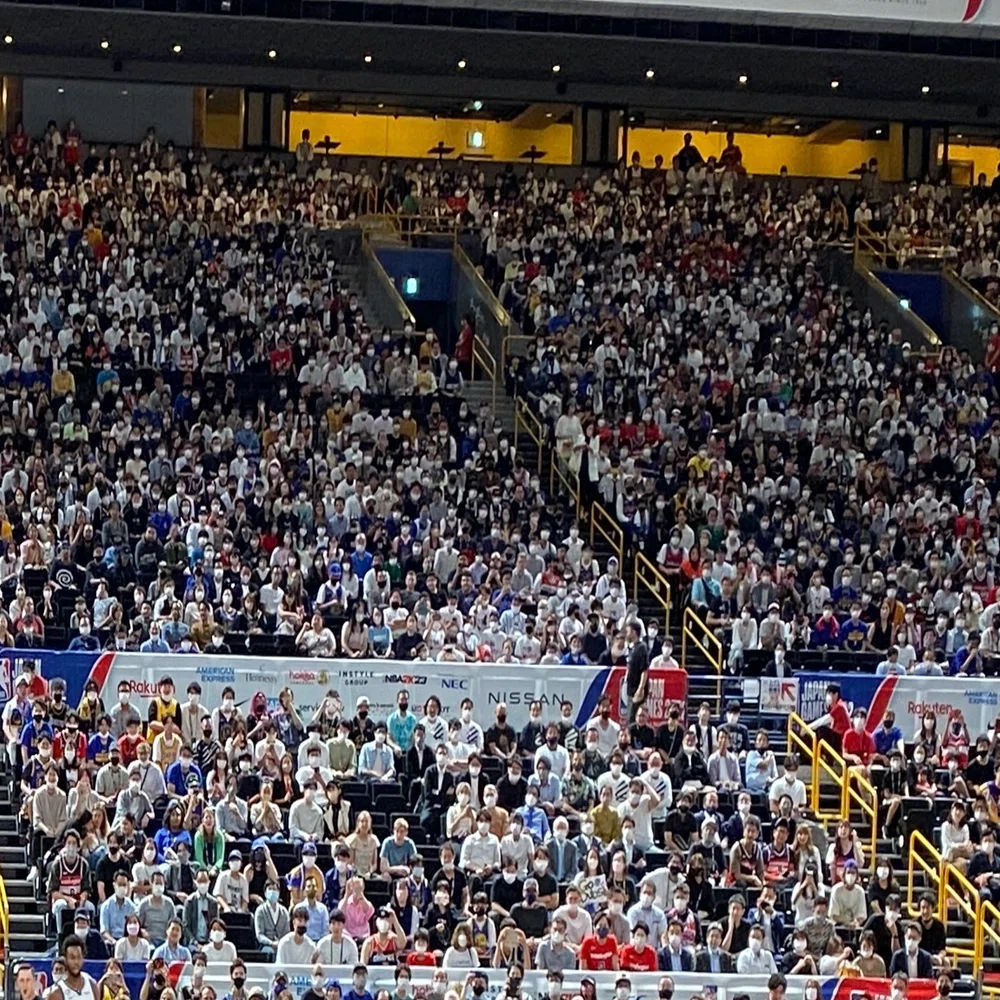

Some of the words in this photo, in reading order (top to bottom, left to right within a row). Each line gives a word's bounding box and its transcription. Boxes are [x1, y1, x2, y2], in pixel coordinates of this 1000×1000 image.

[196, 667, 235, 676] AMERICAN
[201, 674, 235, 683] EXPRESS
[441, 679, 469, 690] NEC
[488, 691, 565, 706] NISSAN
[908, 701, 953, 716] Rakuten
